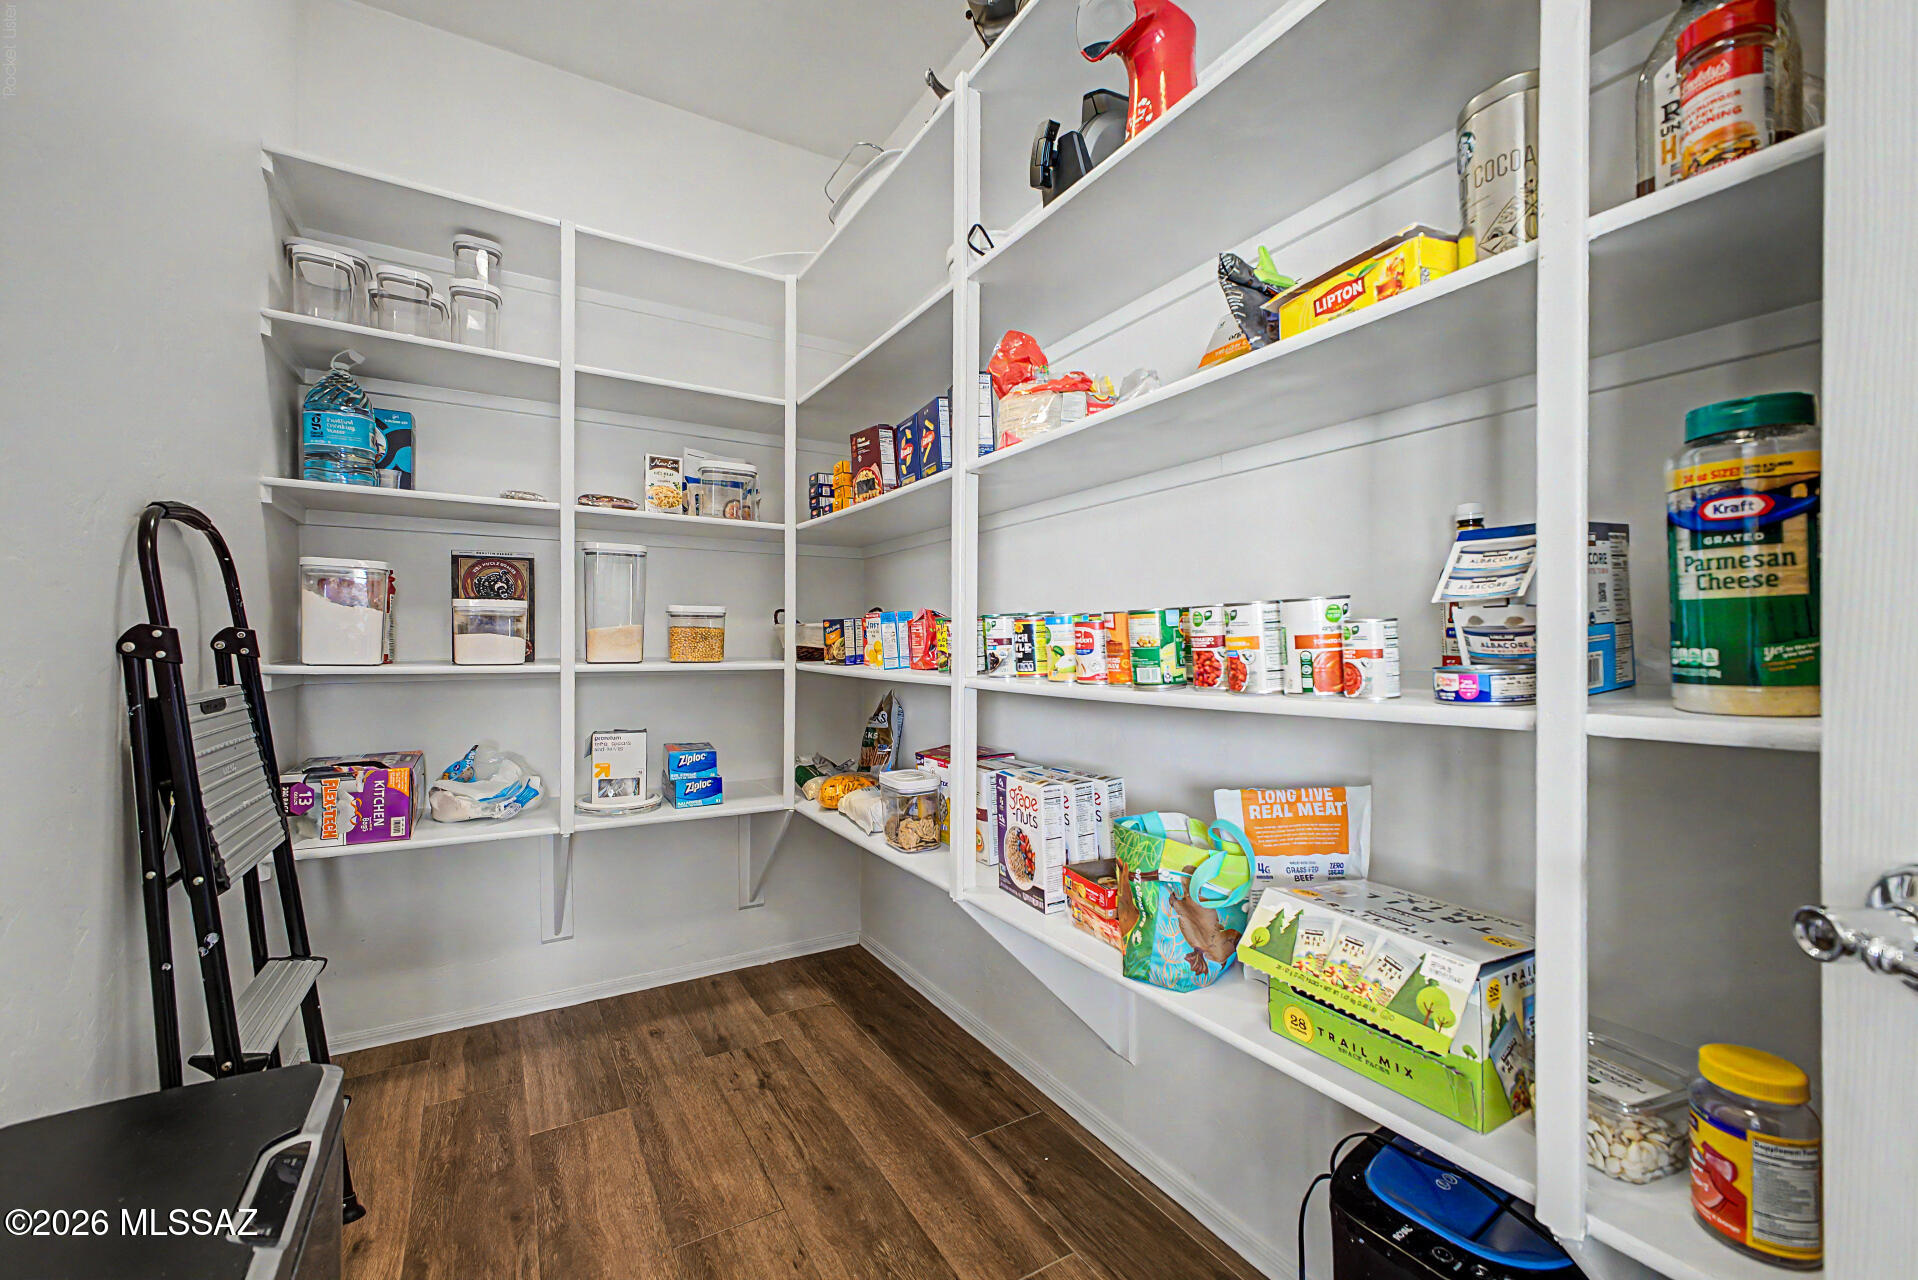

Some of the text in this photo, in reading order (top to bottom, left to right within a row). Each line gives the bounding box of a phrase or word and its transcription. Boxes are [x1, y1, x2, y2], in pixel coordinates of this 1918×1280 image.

[1473, 144, 1537, 189] COCOA
[1314, 278, 1364, 315] LIPTON
[1710, 467, 1741, 480] SIZE!
[1712, 499, 1755, 515] Kraft
[1703, 531, 1765, 546] GRATED
[1588, 552, 1608, 565] CORE
[1683, 551, 1798, 573] Parmesan
[1697, 572, 1779, 592] Cheese
[1480, 641, 1530, 649] ALBACORE
[678, 752, 707, 767] Ziploc
[685, 779, 713, 795] Ziploc
[1257, 787, 1334, 804] LONG LIVE
[298, 790, 313, 806] 13
[373, 780, 385, 827] KITCHEN
[1008, 785, 1039, 812] grape
[321, 779, 340, 840] FLEX-TECH
[1248, 804, 1294, 820] REAL
[1012, 808, 1039, 829] -nuts
[1329, 862, 1344, 870] ZERO
[1290, 1014, 1307, 1031] 28
[1316, 1026, 1414, 1079] TRAIL MIX
